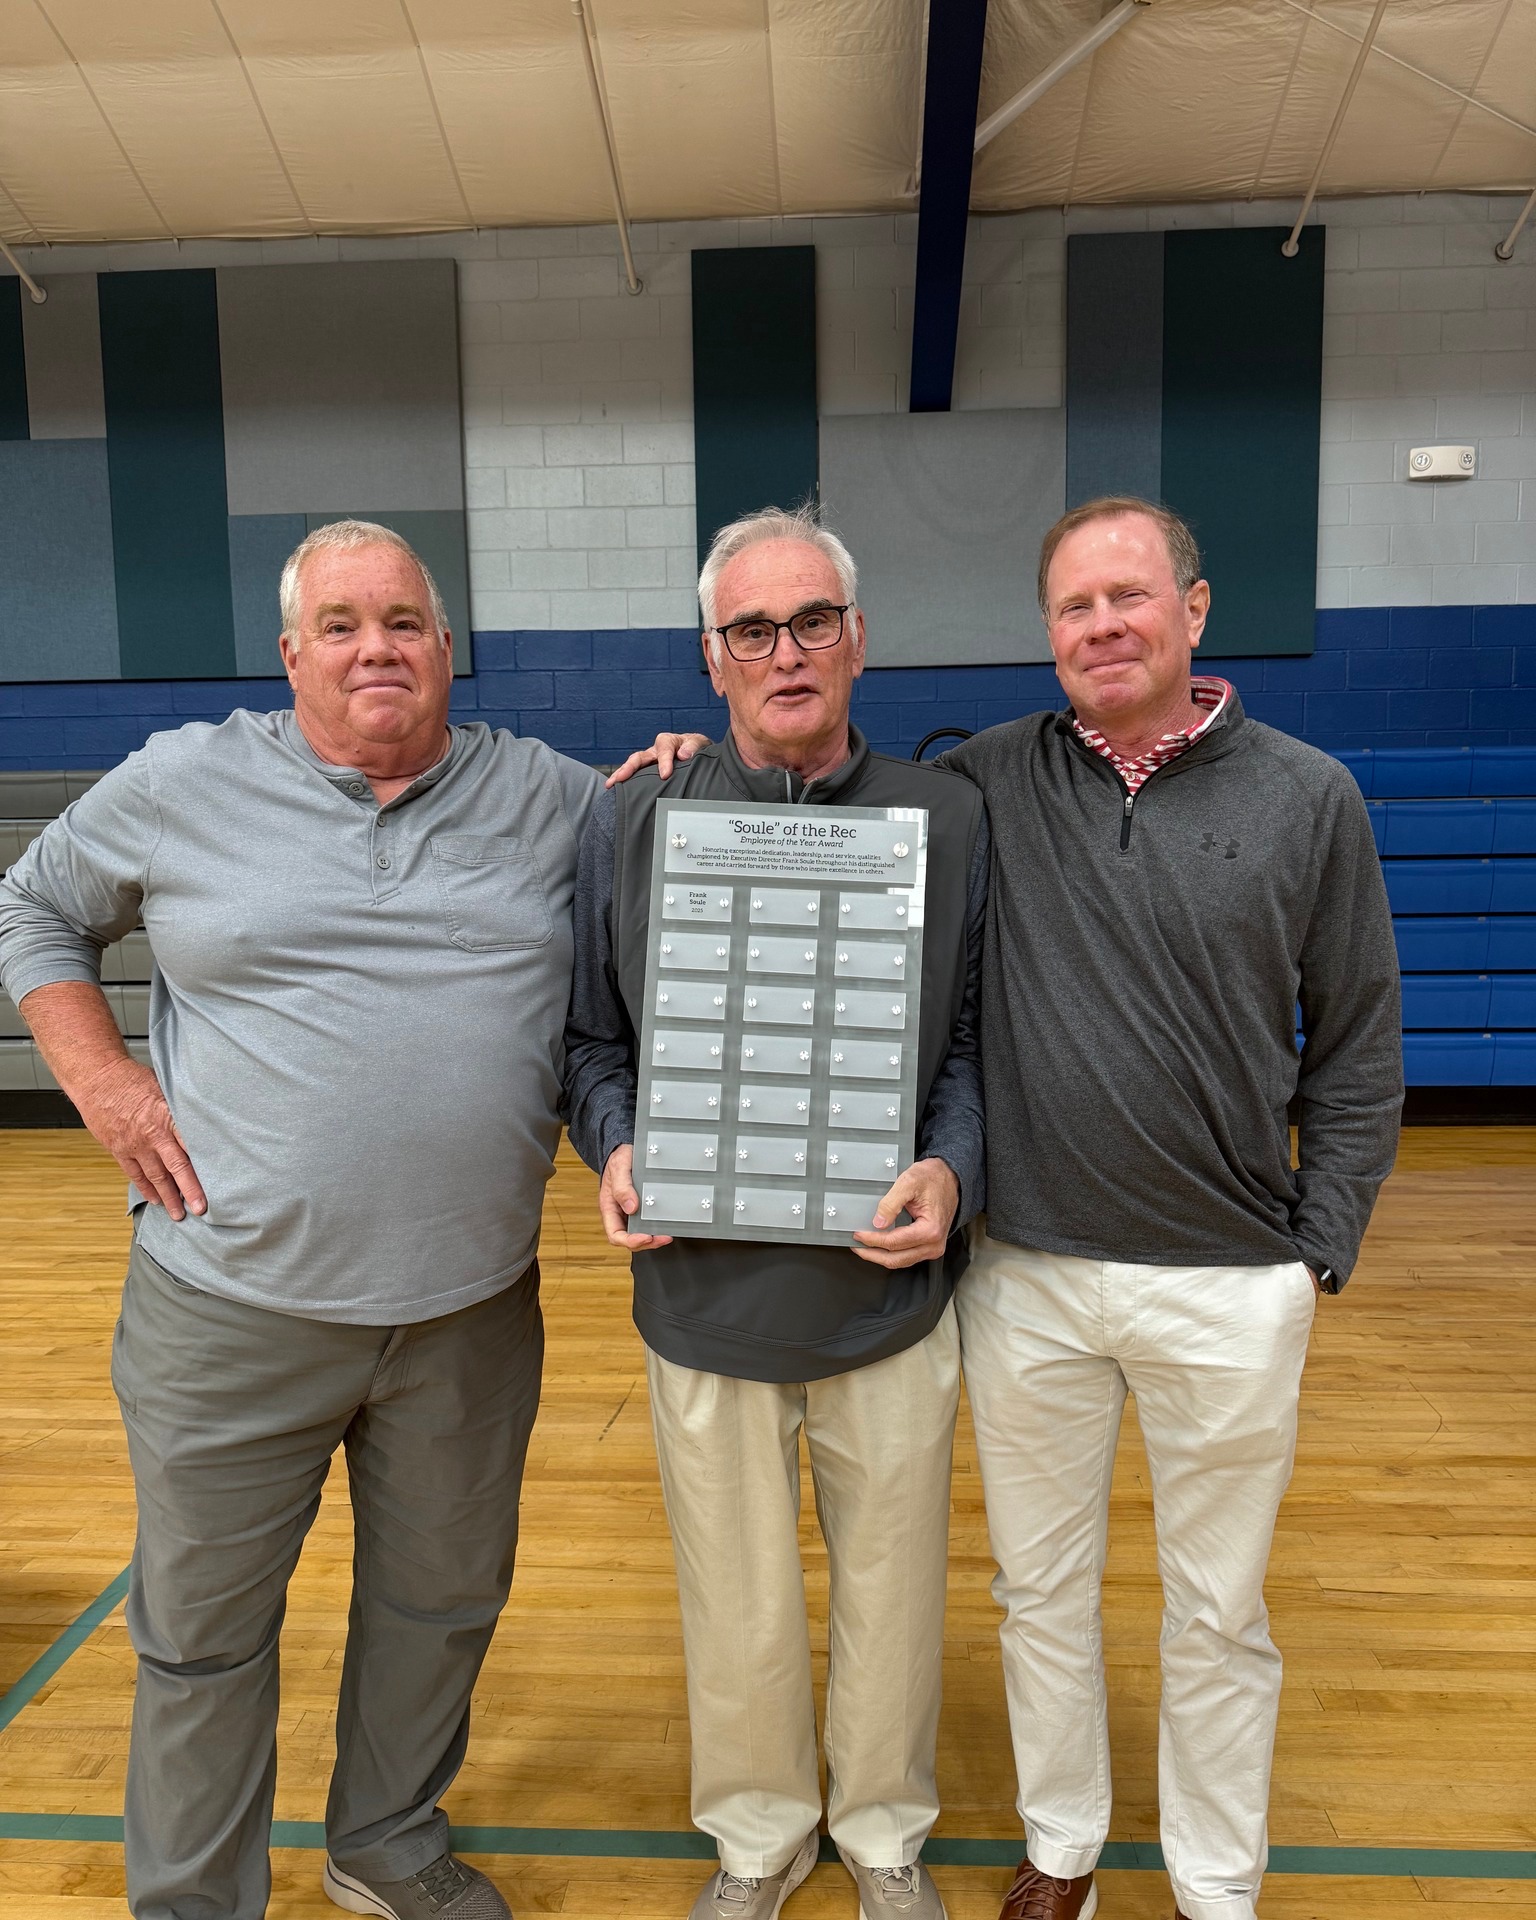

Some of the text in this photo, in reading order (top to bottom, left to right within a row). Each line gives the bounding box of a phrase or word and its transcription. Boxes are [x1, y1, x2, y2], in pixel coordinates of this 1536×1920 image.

[783, 823, 798, 835] of
[802, 824, 826, 837] the
[830, 825, 856, 838] Rec
[741, 836, 776, 845] Employee
[777, 838, 785, 846] of
